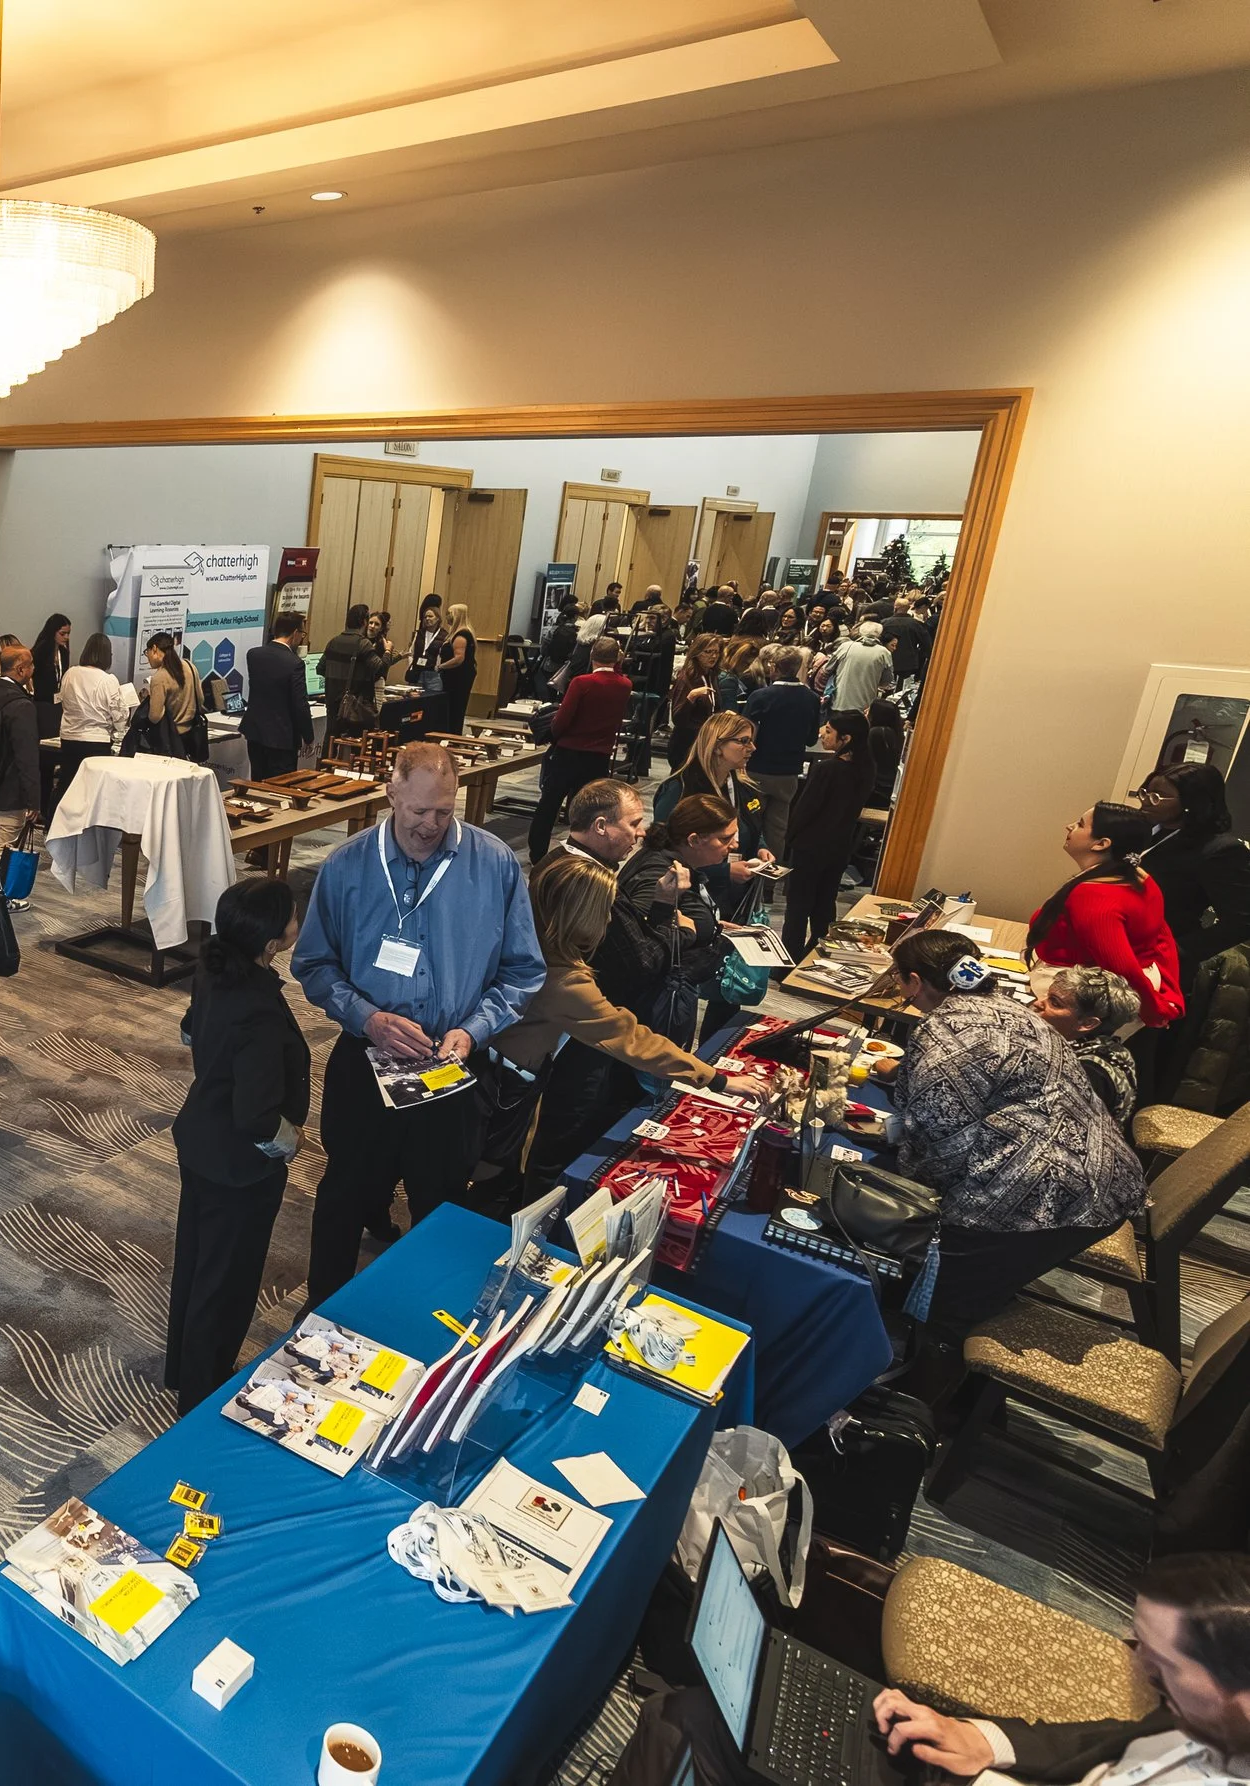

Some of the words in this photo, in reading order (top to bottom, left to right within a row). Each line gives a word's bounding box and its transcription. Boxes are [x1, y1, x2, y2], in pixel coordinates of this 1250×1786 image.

[206, 554, 258, 570] chatterhigh
[206, 574, 257, 582] www.ChatterHigh.com
[186, 620, 209, 628] Empower
[210, 618, 219, 626] Life
[233, 616, 243, 624] High
[500, 1542, 531, 1561] areer
